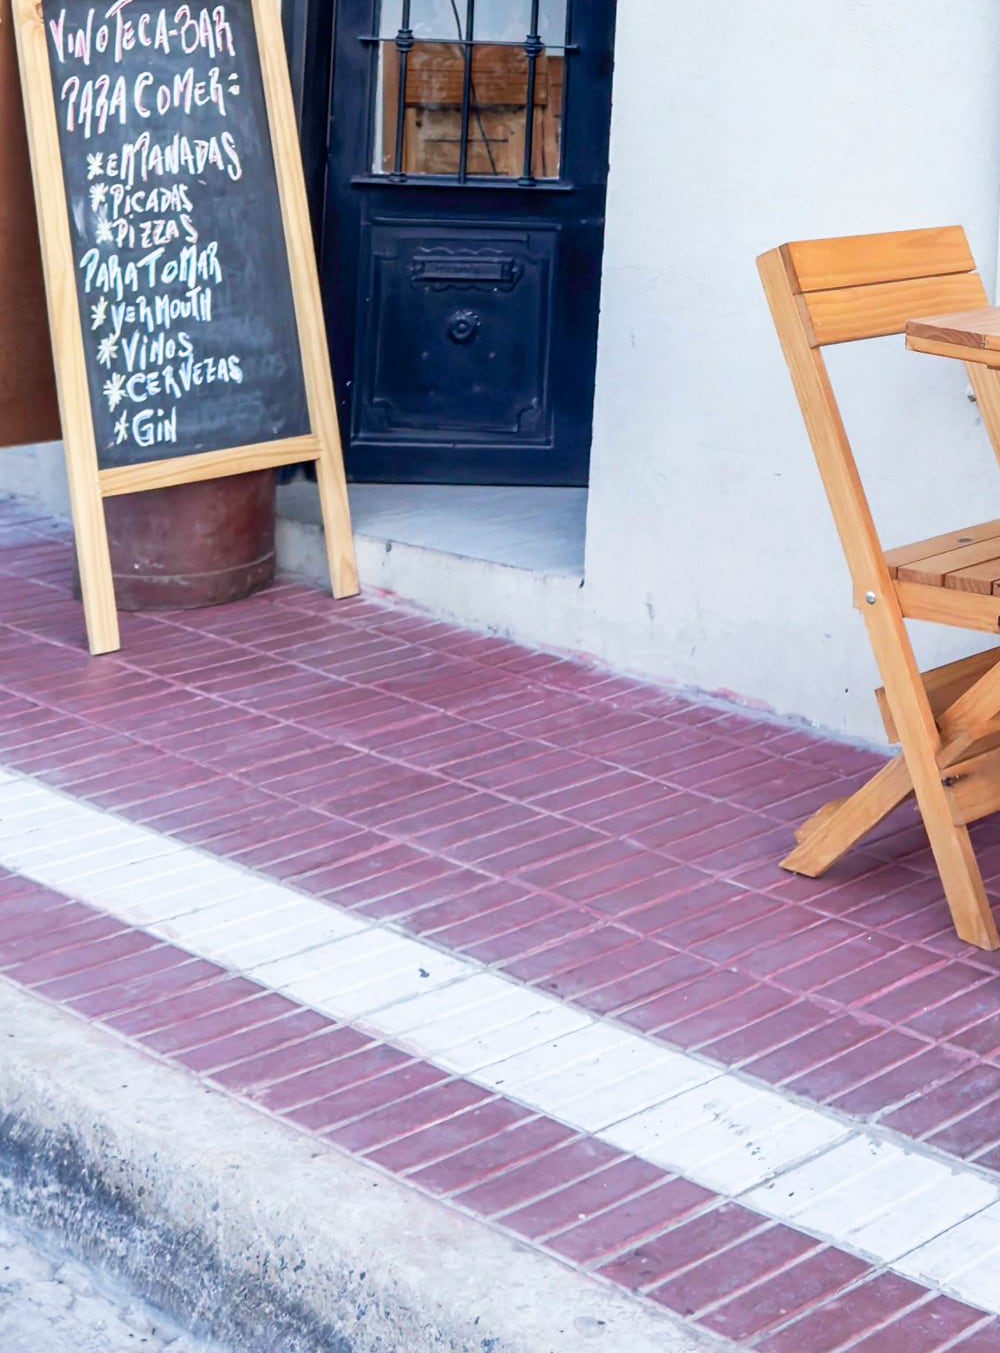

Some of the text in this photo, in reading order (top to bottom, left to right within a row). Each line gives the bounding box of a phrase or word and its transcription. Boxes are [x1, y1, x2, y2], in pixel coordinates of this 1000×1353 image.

[60, 74, 127, 139] PARA
[79, 240, 223, 302] PARA TOMAR
[111, 285, 212, 339] VERMOUTH
[126, 352, 244, 403] CERVEZAS
